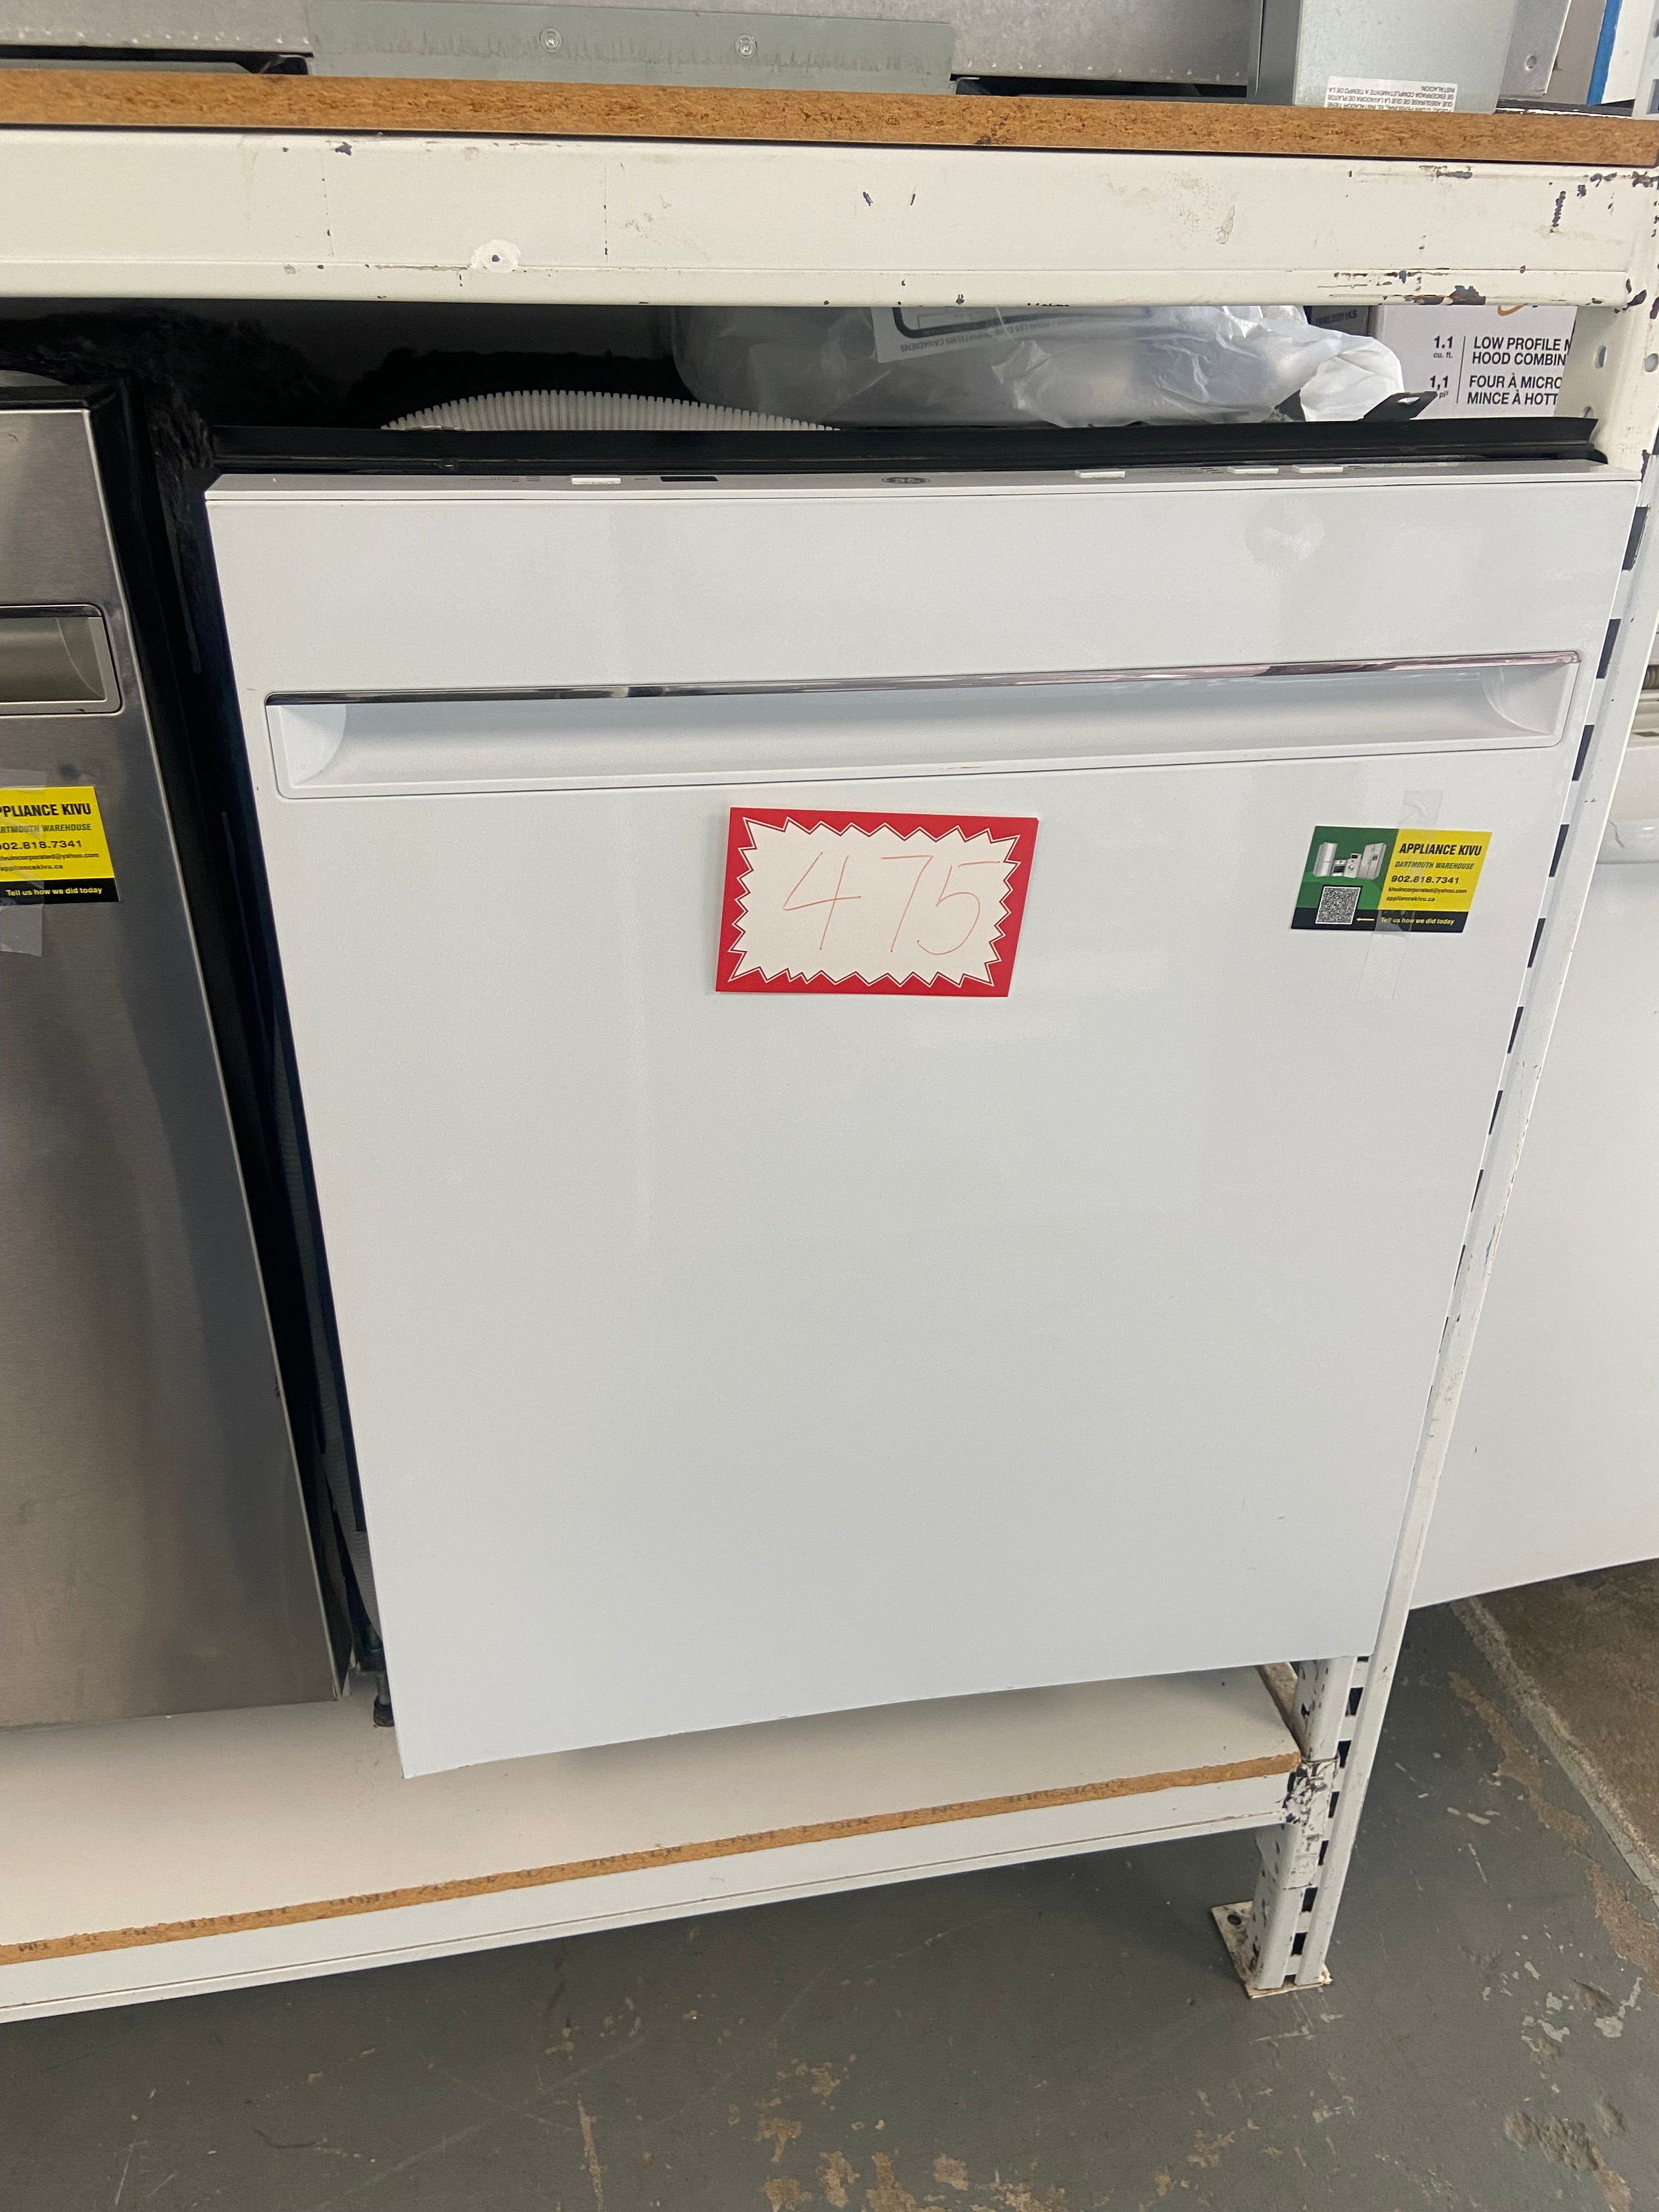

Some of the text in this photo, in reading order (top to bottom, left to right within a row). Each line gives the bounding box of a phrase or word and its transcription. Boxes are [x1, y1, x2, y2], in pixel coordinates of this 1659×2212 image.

[1434, 336, 1453, 349] 1.1
[1474, 336, 1504, 349] LOW
[1506, 337, 1561, 351] PROFILE
[1472, 352, 1510, 364] HOOD
[1430, 375, 1448, 390] 1,1
[1469, 375, 1505, 388] FOUR
[1508, 373, 1517, 388] À
[1467, 392, 1509, 405] MINCE
[1512, 390, 1521, 405] À
[61, 803, 92, 815] KIVU
[42, 823, 92, 832] WAREHOUSE
[0, 840, 82, 850] 02.818.7341
[1399, 843, 1482, 856] APPLIANCE KIVU
[1391, 875, 1459, 884] 902.818.7341
[783, 852, 1000, 955] 475
